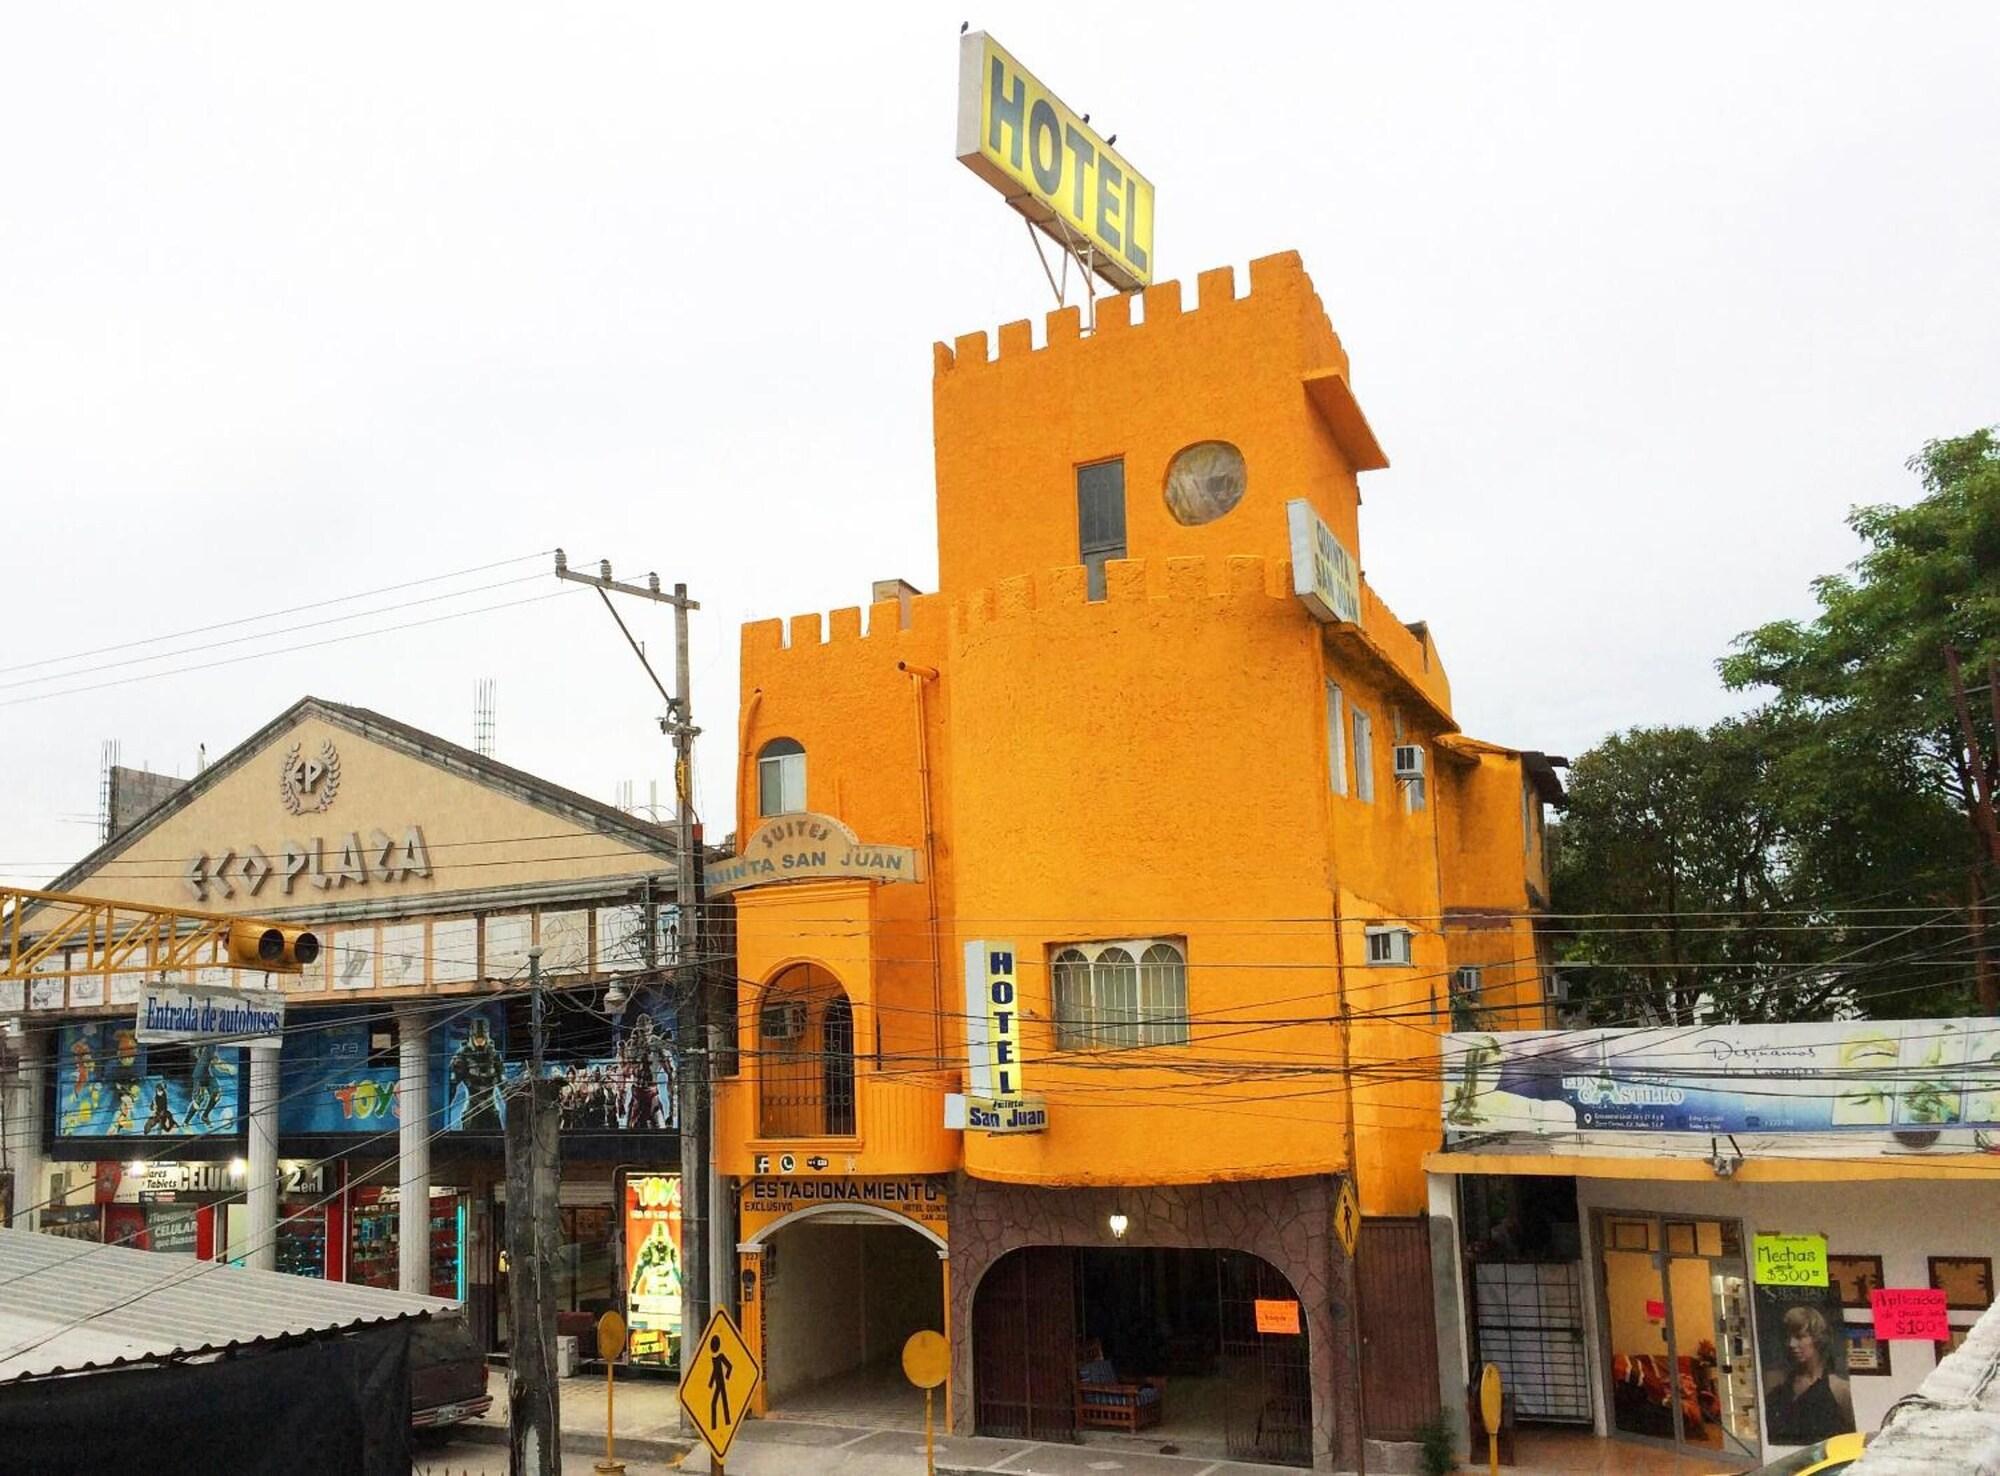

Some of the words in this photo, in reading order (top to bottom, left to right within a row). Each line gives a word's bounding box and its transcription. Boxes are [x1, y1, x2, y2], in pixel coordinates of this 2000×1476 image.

[990, 54, 1147, 273] HOTEL
[761, 820, 832, 849] SUITES
[184, 845, 272, 901] ECO
[281, 825, 432, 896] PLAZA
[782, 852, 826, 869] SAN
[840, 852, 903, 870] JUAN
[145, 996, 199, 1031] Entrada
[201, 998, 217, 1033] de
[219, 1000, 280, 1033] autobuses
[990, 952, 1015, 1094] HOTEL
[970, 1106, 1000, 1127] San
[1007, 1109, 1046, 1127] Juan
[754, 1181, 937, 1201] ESTACIONAMIENTO
[744, 1202, 793, 1213] EXCLUSIVO
[1758, 1246, 1816, 1264] Mechas
